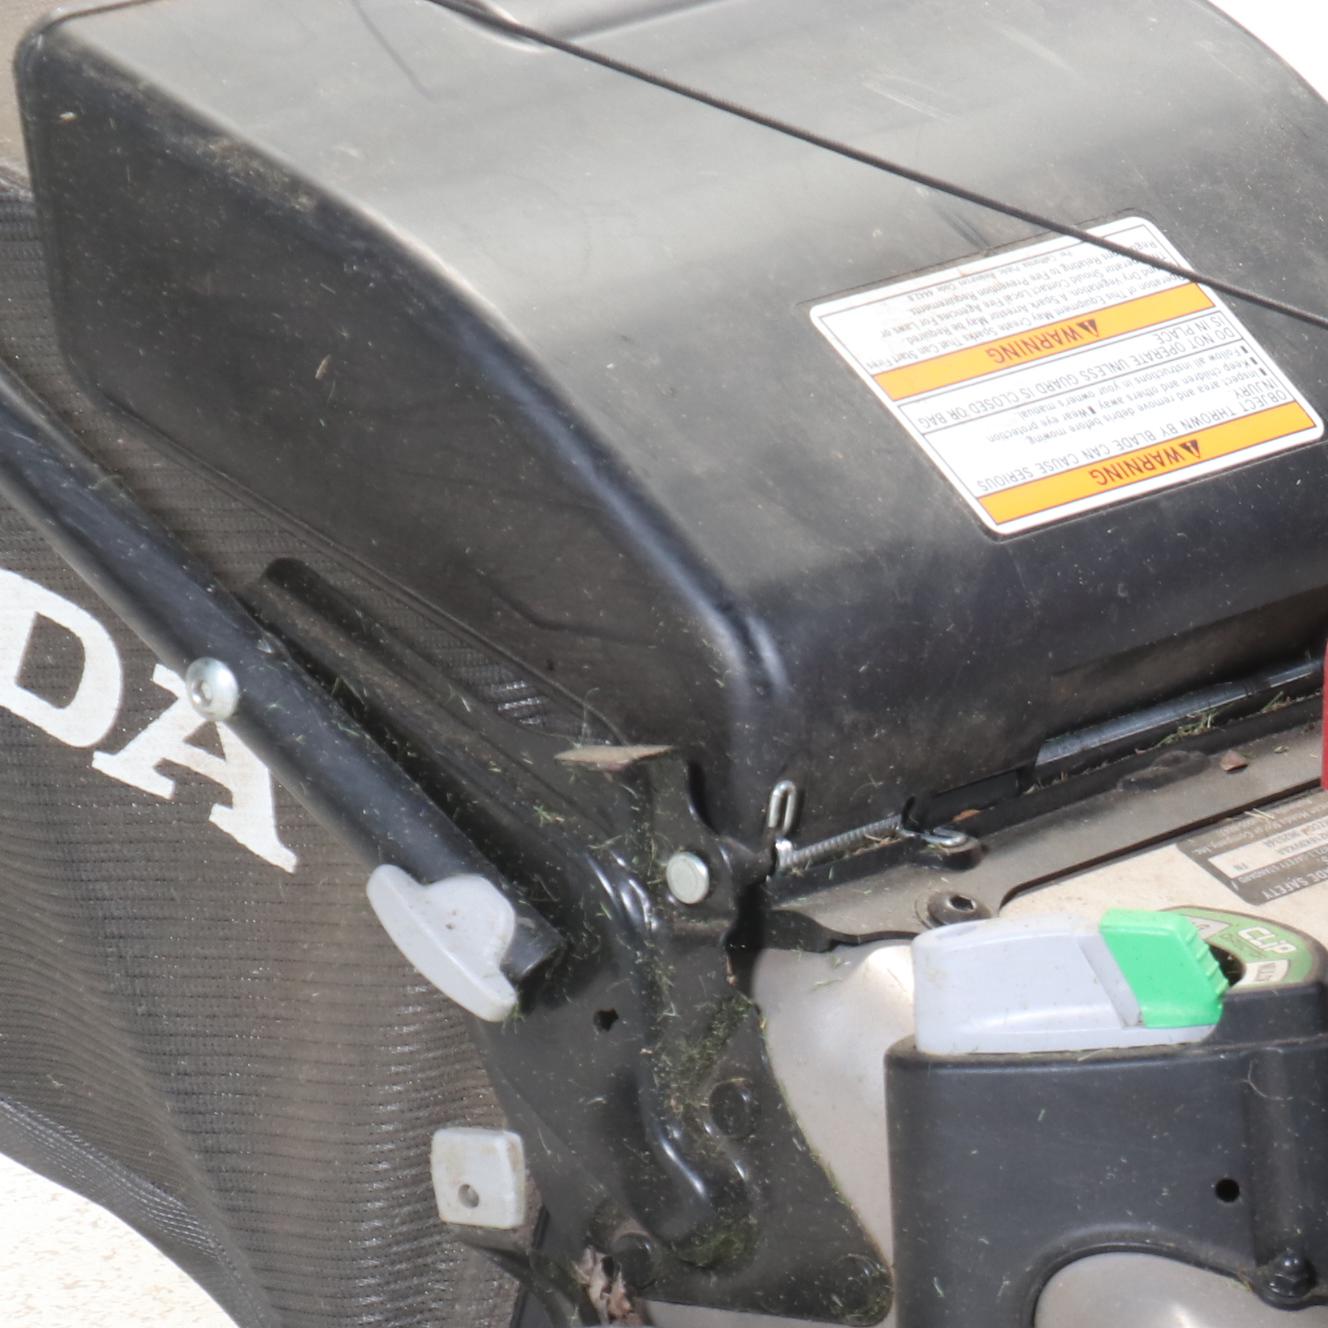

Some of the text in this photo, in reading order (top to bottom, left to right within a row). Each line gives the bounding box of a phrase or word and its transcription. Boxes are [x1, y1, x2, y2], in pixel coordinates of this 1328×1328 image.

[1061, 255, 1101, 272] Relating
[1030, 271, 1048, 281] Fire
[1048, 267, 1061, 275] to
[1071, 269, 1103, 284] Should
[1123, 271, 1140, 281] Dry
[977, 277, 1028, 296] Prevention
[1032, 279, 1070, 295] Contact
[1126, 286, 1138, 294] of
[1005, 290, 1031, 303] Local
[1030, 295, 1058, 309] Spark
[1107, 290, 1125, 301] This
[984, 298, 1002, 309] Fire
[1054, 295, 1104, 315] Equipment
[937, 303, 981, 322] Agencies
[990, 305, 1028, 321] Arrestor
[1032, 309, 1053, 322] May
[920, 317, 937, 327] For
[950, 323, 966, 331] be
[966, 315, 987, 327] May
[999, 317, 1030, 332] Create
[1194, 320, 1210, 331] IN
[1209, 315, 1225, 326] IS
[878, 329, 892, 337] or
[893, 322, 918, 335] Laws
[963, 326, 996, 342] Sparks
[918, 344, 939, 355] Can
[939, 337, 961, 349] That
[986, 325, 1080, 363] WARNING
[892, 350, 917, 363] Start
[1209, 348, 1239, 362] Follow
[867, 357, 892, 370] Fires
[1192, 358, 1207, 367] all
[1223, 358, 1248, 372] Keep
[919, 327, 1234, 428] DO NOT OPERATE UNLESS GUARD IS CLOSED OR BAG
[1135, 363, 1191, 384] instructions
[1182, 367, 1221, 384] children
[1222, 369, 1258, 385] Inspect
[1097, 381, 1119, 393] your
[1121, 380, 1133, 388] in
[1161, 380, 1179, 391] and
[1198, 381, 1219, 392] area
[1127, 386, 1158, 401] others
[1177, 389, 1195, 399] and
[1137, 395, 1174, 411] remove
[1040, 415, 1058, 426] eye
[1062, 408, 1087, 421] Wear
[1104, 407, 1135, 422] debris
[1070, 418, 1101, 432] before
[977, 389, 1287, 490] OBJECT THROWN BY BLADE CAN CAUSE SERIOUS
[1089, 445, 1184, 485] WARNING
[0, 566, 297, 874] DA
[1261, 877, 1309, 899] SAFETY
